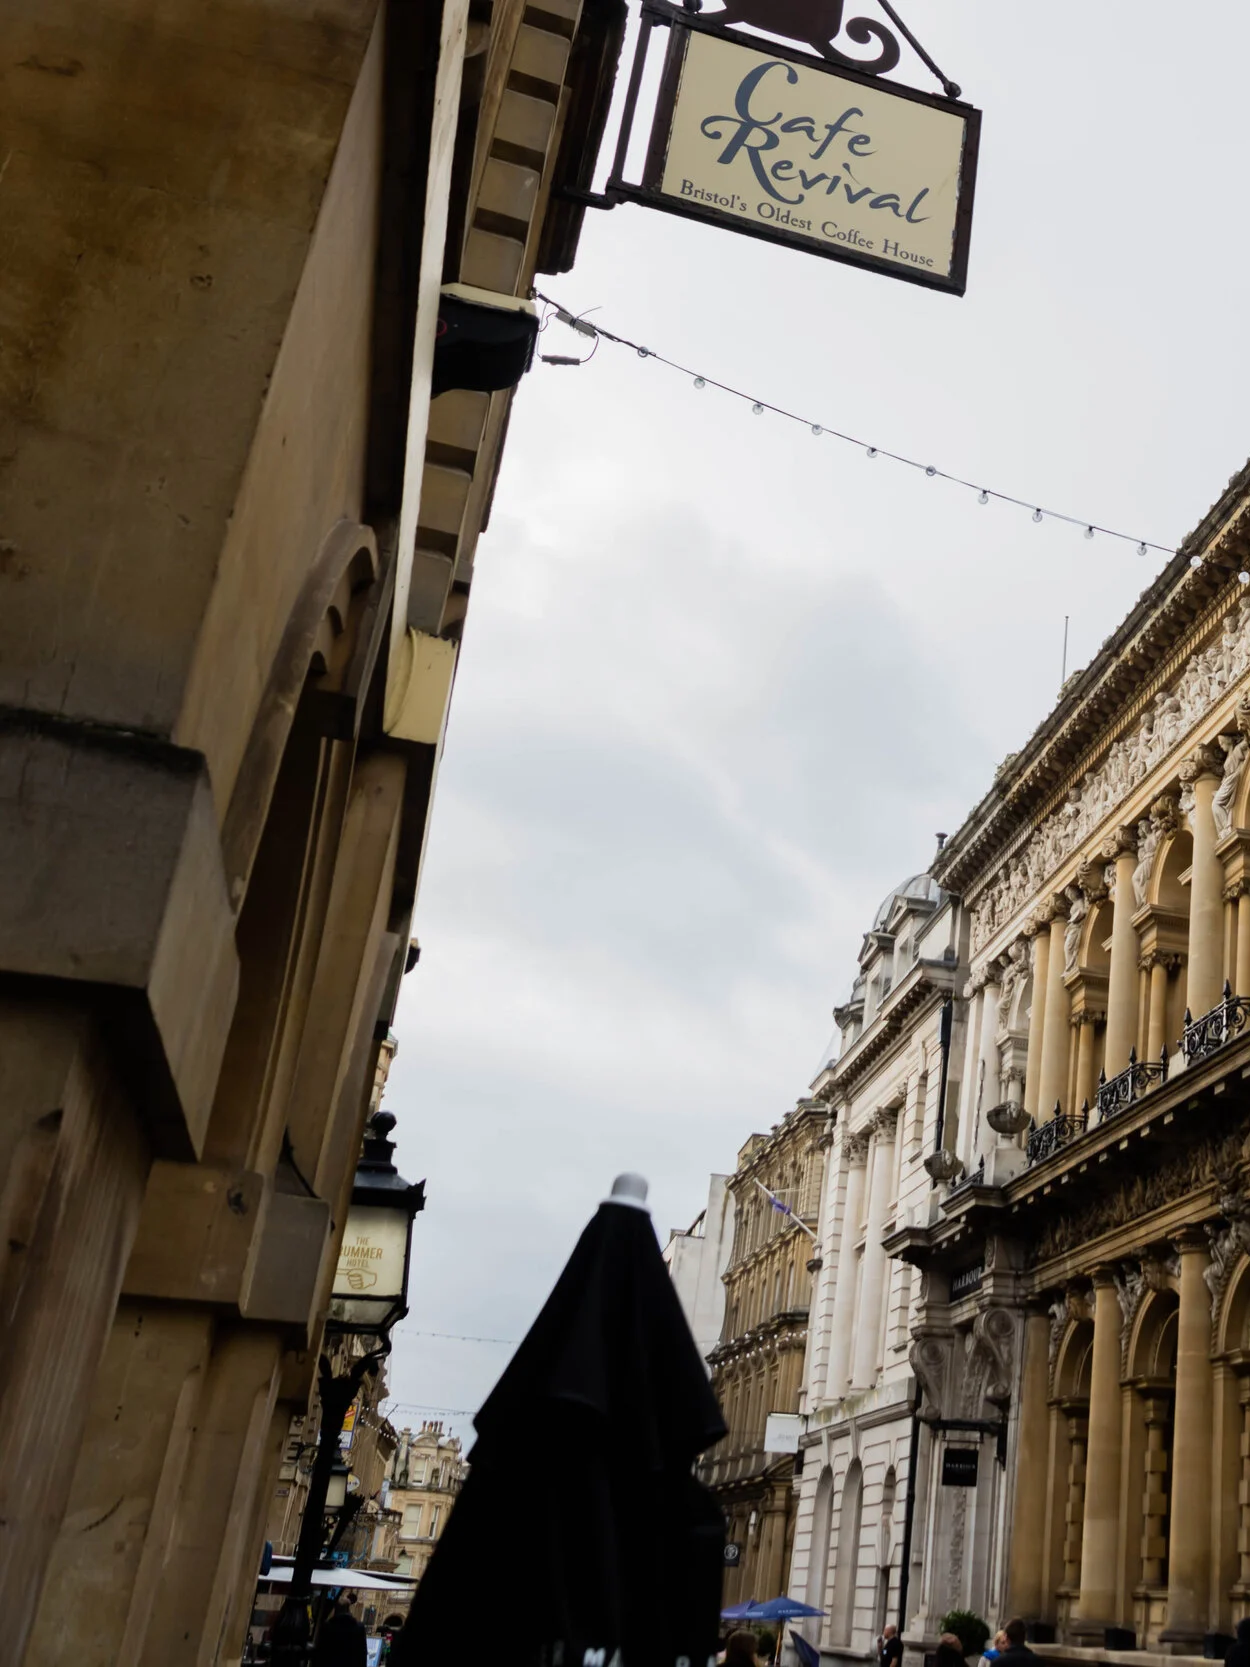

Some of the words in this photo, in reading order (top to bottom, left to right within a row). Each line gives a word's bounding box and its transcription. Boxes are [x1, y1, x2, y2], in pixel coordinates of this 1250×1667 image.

[735, 61, 878, 160] Cafe
[700, 115, 933, 224] Revival
[680, 179, 748, 214] Bristol's
[757, 202, 812, 231] Oldest
[821, 221, 874, 249] Coffee
[882, 239, 934, 267] House
[346, 1258, 369, 1268] HOTEL
[356, 1236, 370, 1246] THE
